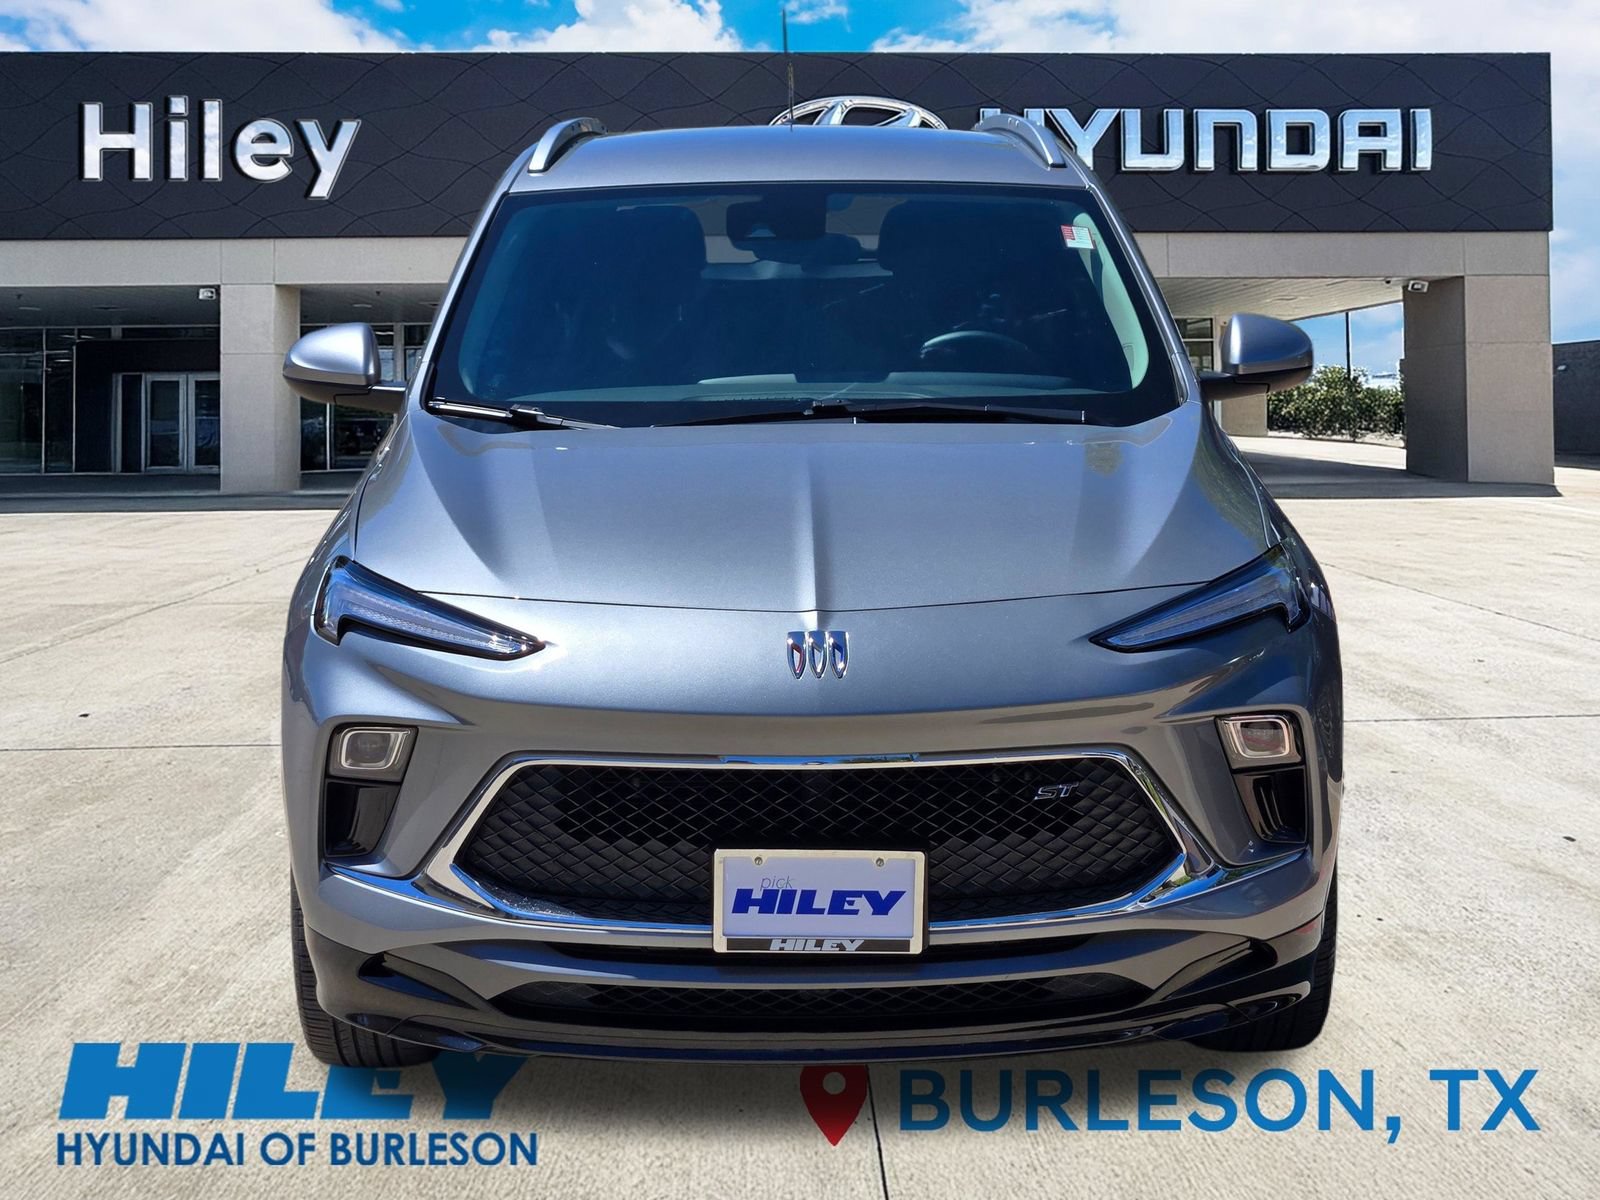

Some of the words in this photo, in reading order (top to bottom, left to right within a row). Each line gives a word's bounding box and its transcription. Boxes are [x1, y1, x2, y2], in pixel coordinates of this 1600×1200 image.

[79, 95, 361, 200] Hiley
[980, 108, 1433, 172] YUNDAI
[1034, 781, 1080, 800] ST
[760, 875, 797, 891] pick
[732, 888, 907, 916] HILEY
[769, 938, 865, 952] HILEY
